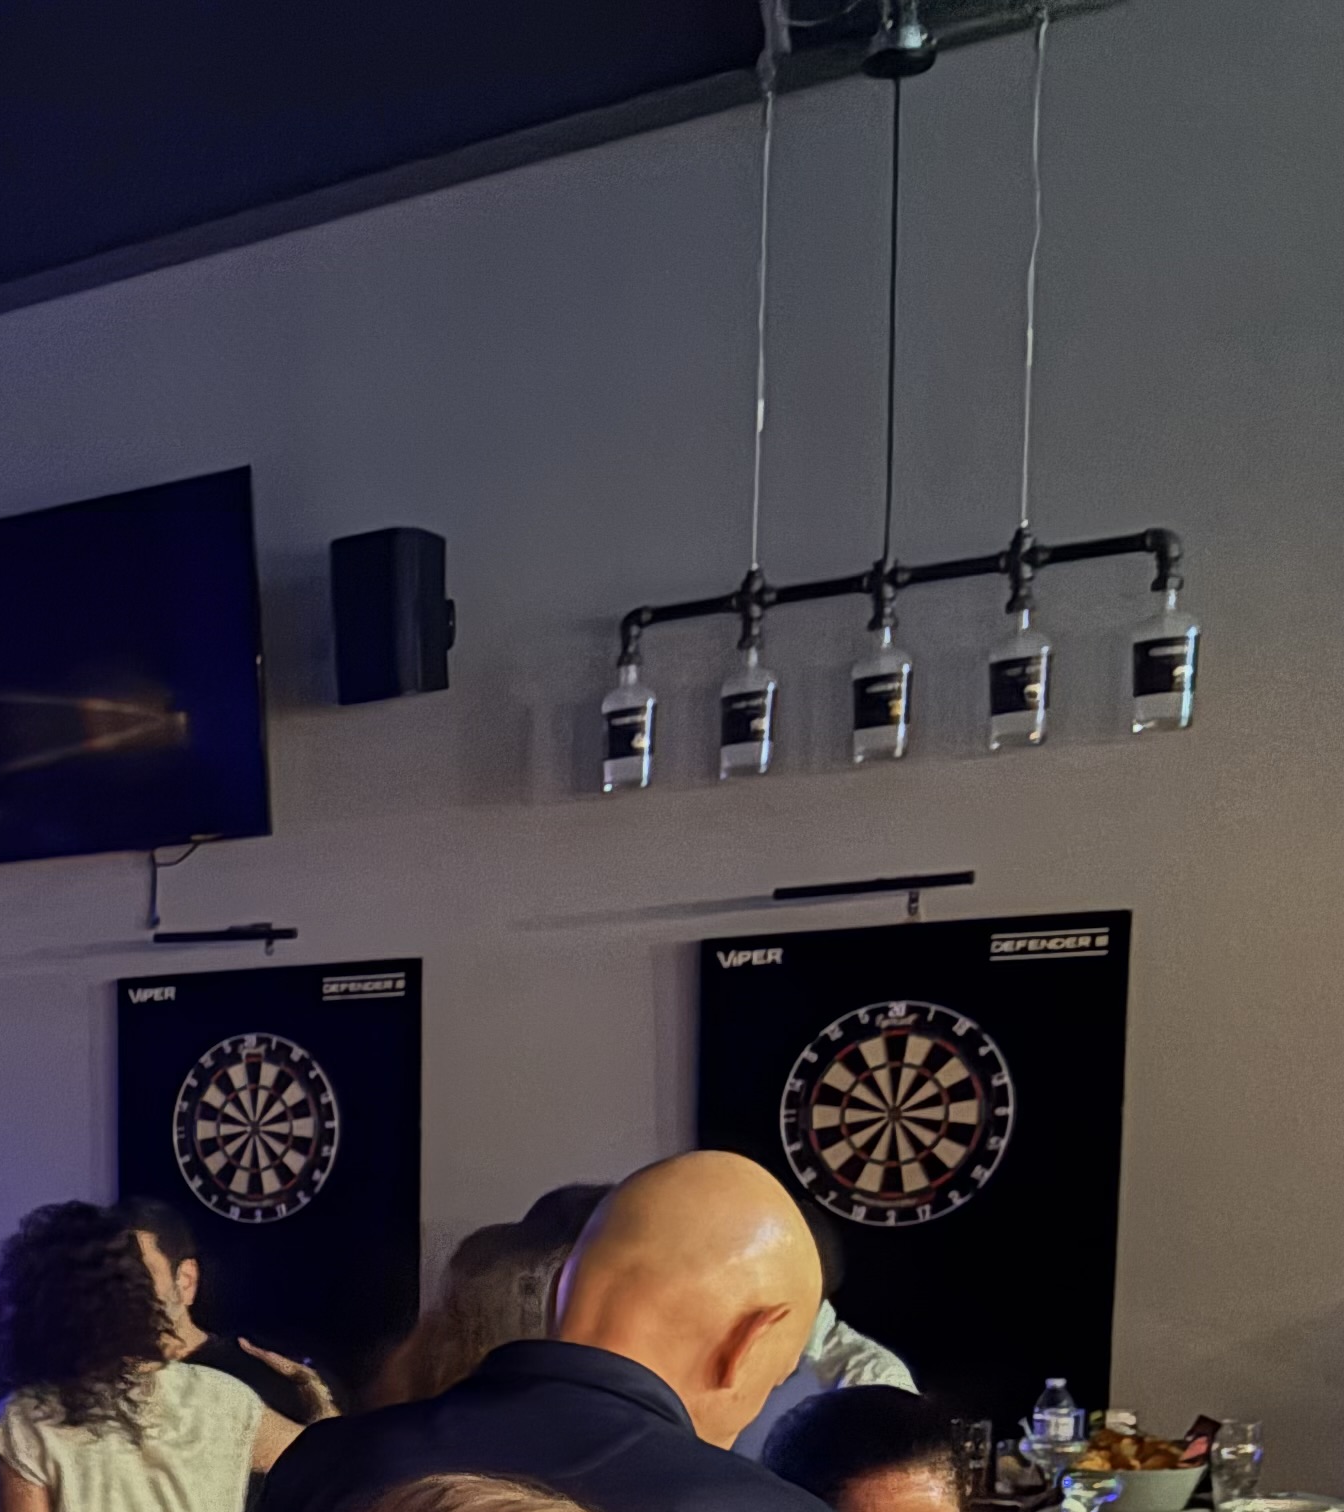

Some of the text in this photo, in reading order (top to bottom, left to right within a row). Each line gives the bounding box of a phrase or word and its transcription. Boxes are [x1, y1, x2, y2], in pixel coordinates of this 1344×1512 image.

[990, 935, 1092, 953] DEFENDER
[322, 979, 393, 994] DEFENDER
[888, 1002, 907, 1018] 20
